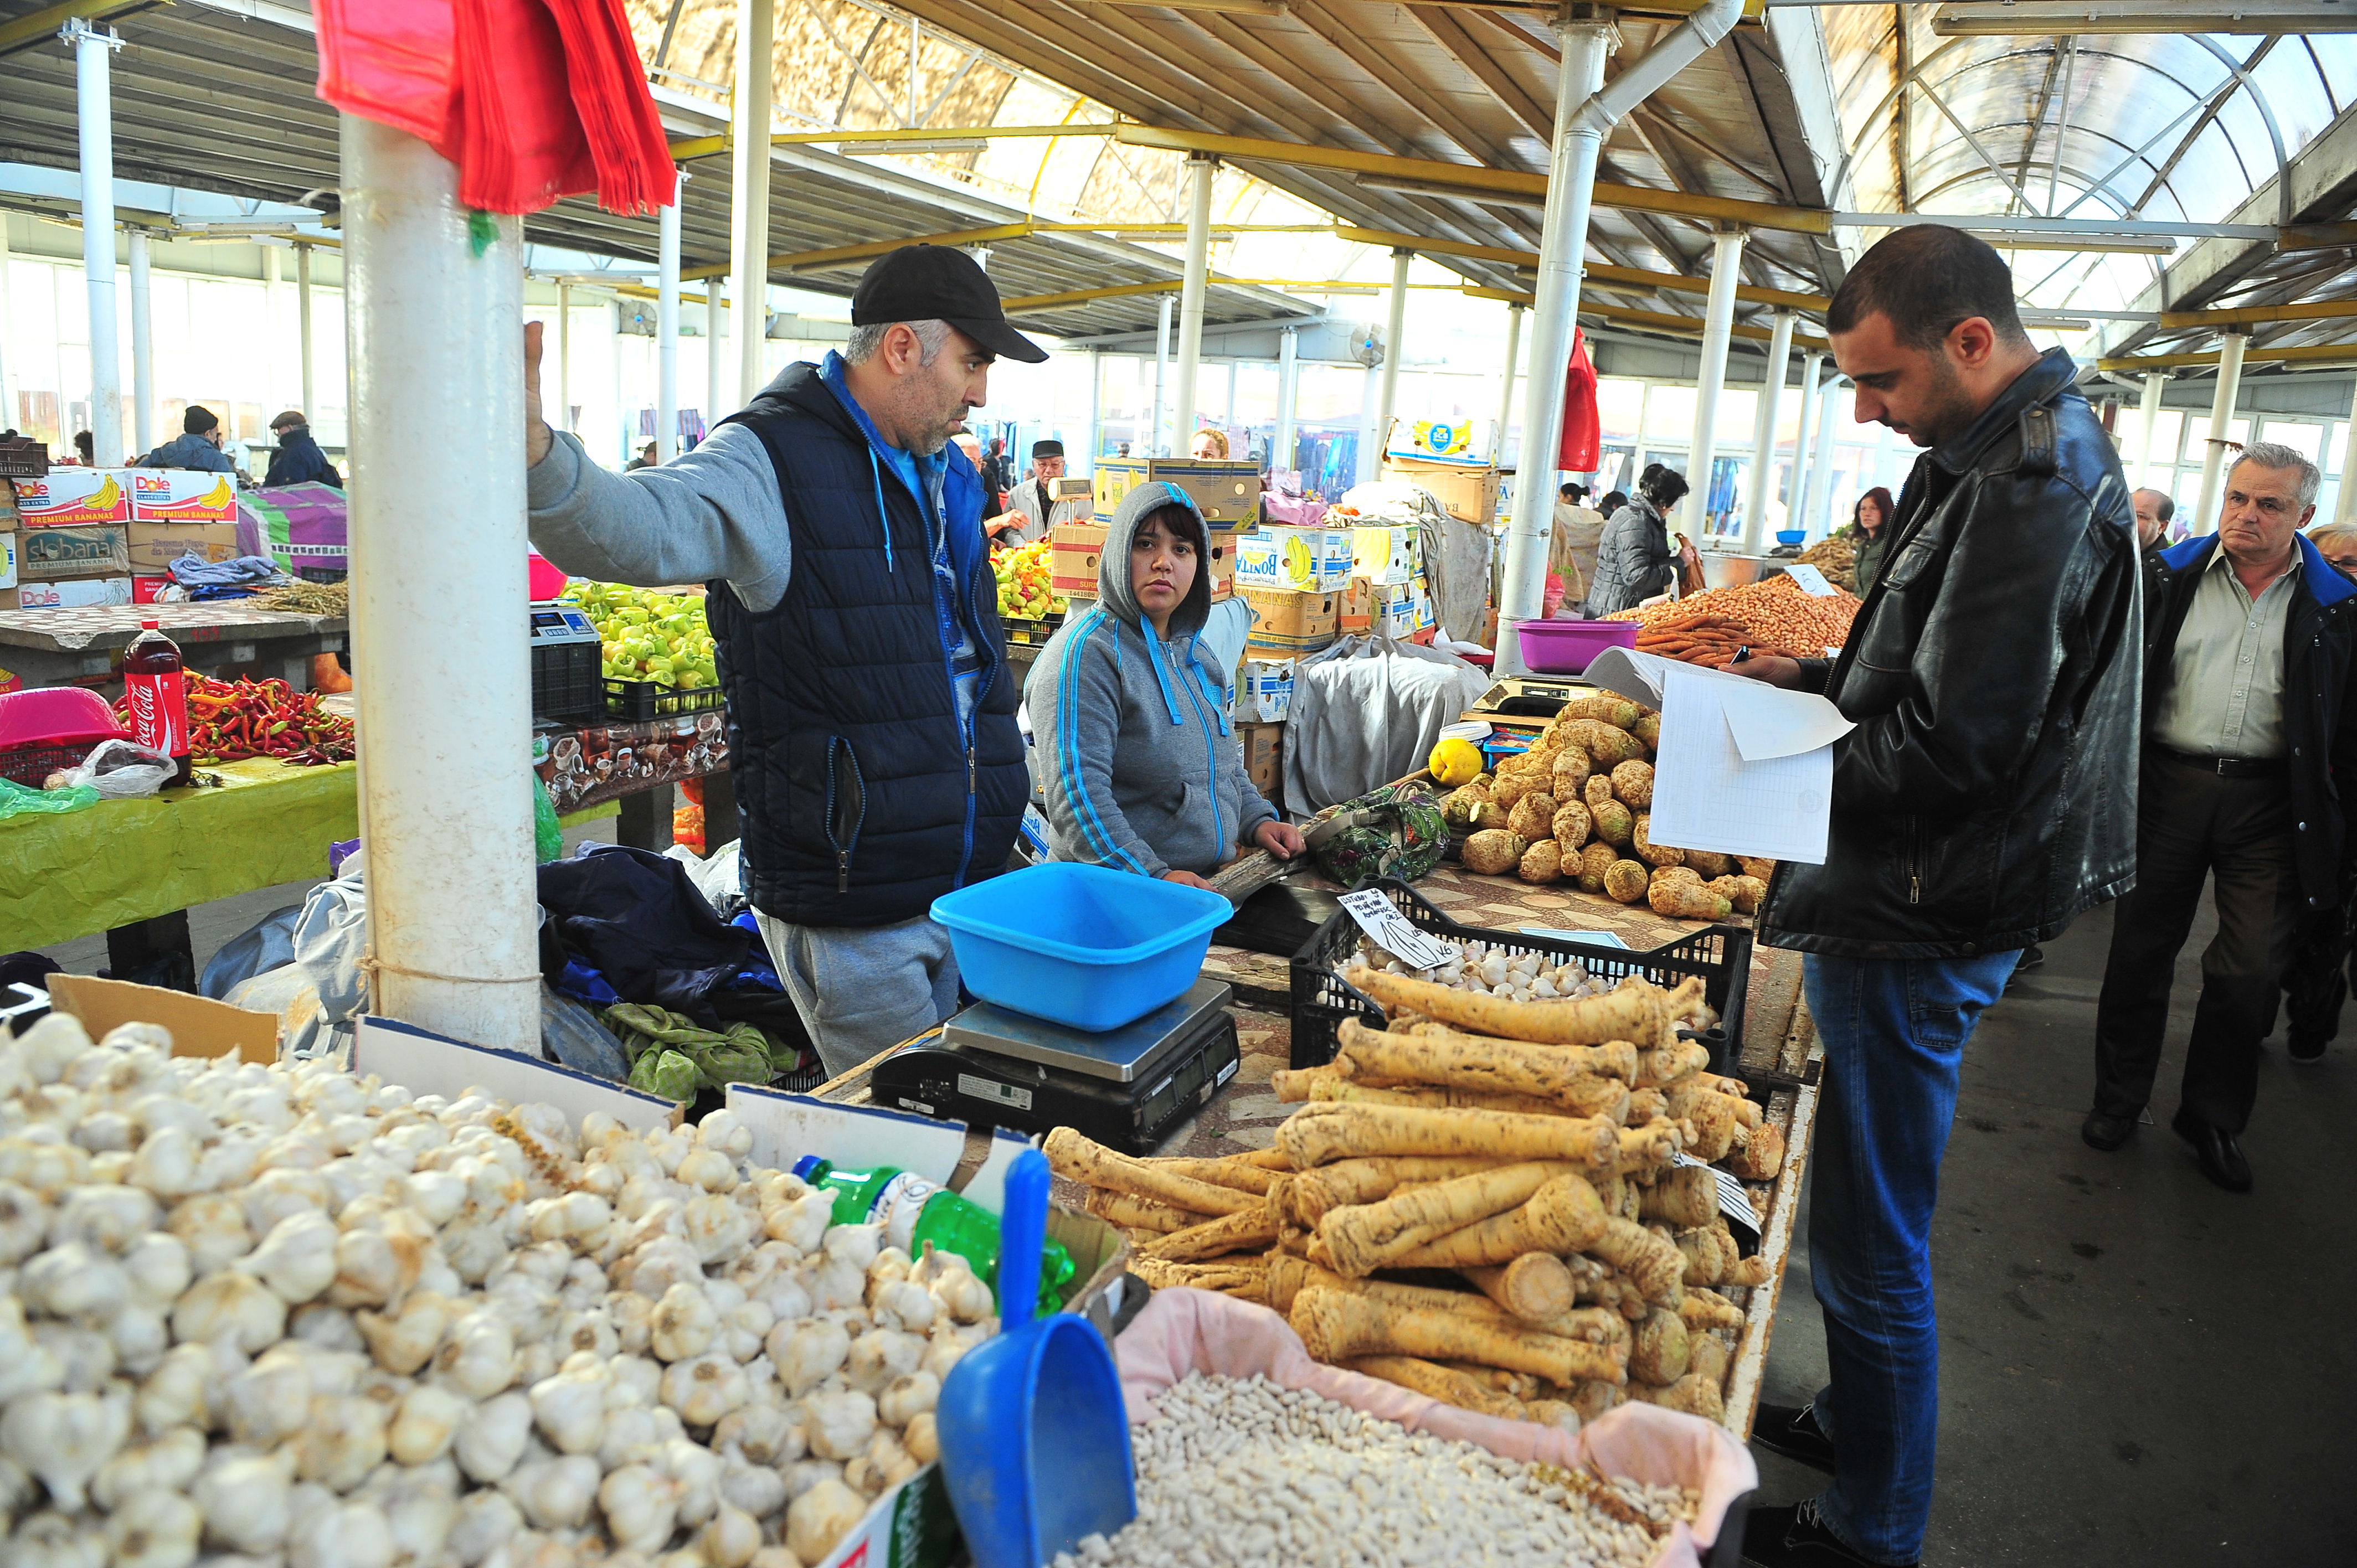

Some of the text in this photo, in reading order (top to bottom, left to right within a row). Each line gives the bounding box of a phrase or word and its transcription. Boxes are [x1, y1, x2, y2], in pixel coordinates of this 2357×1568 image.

[136, 476, 171, 492] Dole
[31, 512, 114, 523] PREMIUM BANANAS
[30, 560, 73, 569] PREMIUM
[1236, 554, 1278, 576] BONITA
[21, 590, 60, 606] Dole
[1234, 588, 1303, 608] BANANAS
[130, 680, 158, 749] oca-Cola
[1436, 945, 1453, 958] KG
